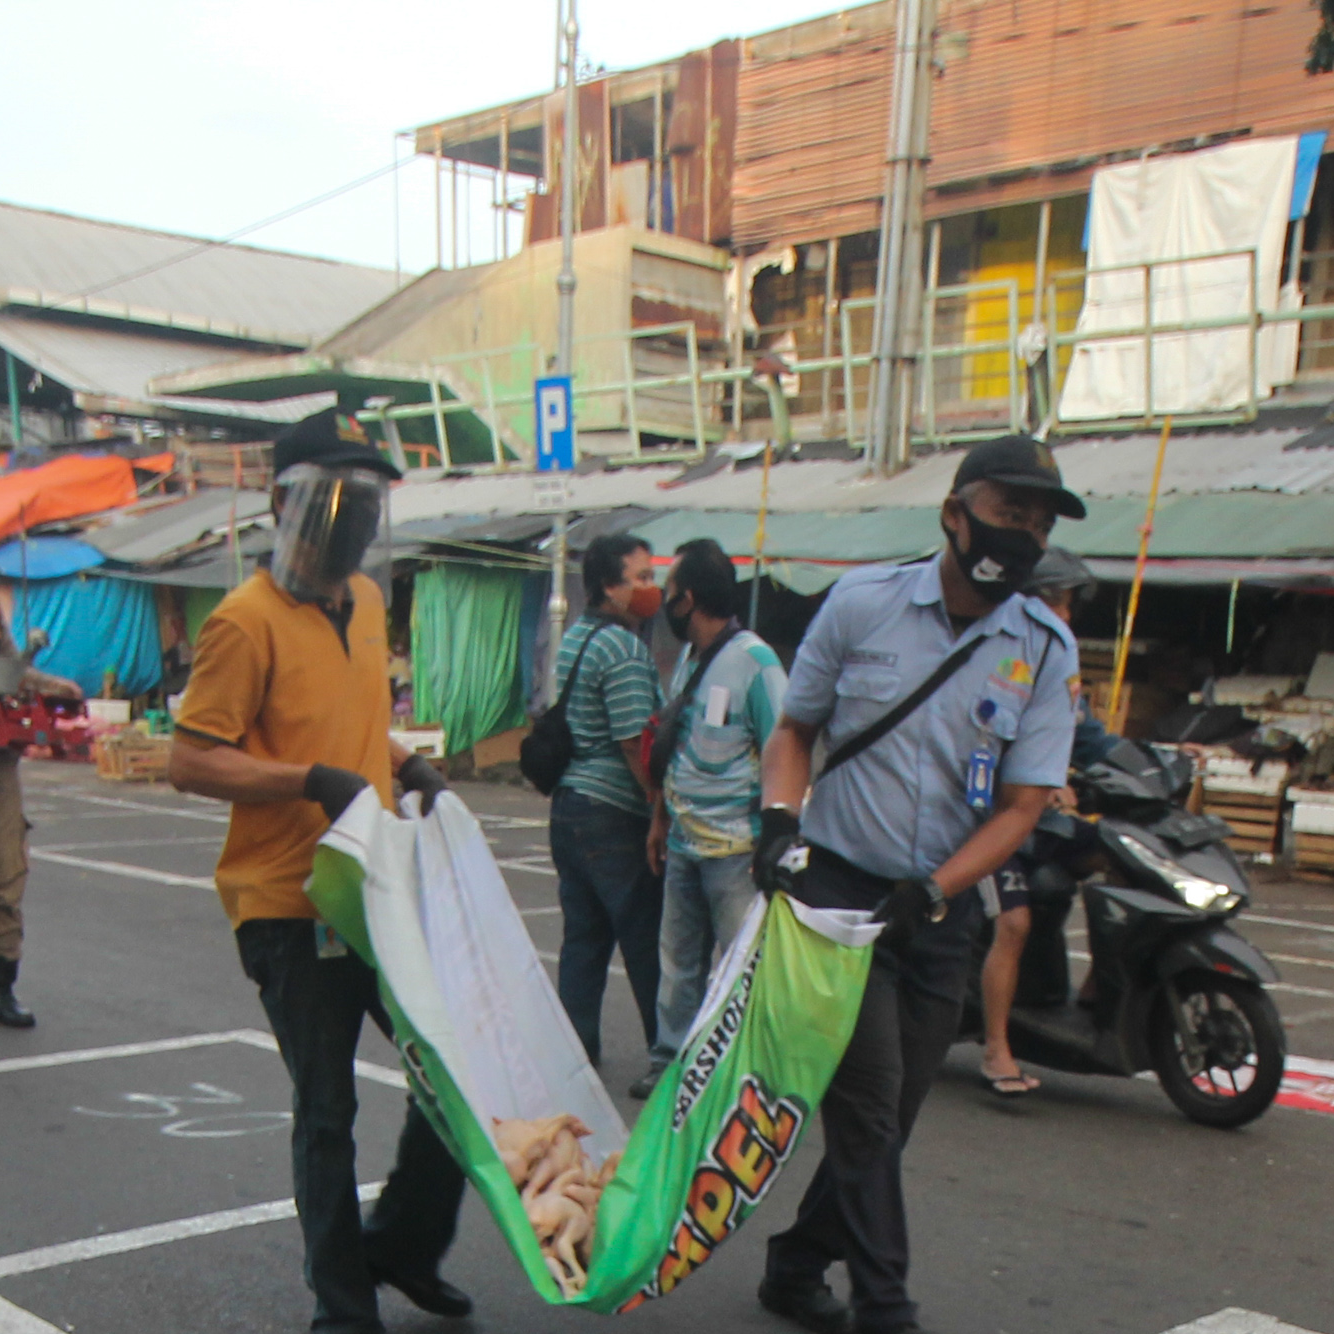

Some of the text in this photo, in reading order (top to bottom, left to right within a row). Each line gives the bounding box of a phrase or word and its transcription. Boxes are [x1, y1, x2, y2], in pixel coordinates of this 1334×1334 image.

[541, 386, 566, 455] P
[70, 1081, 294, 1138] 30
[618, 1075, 802, 1313] MPEL
